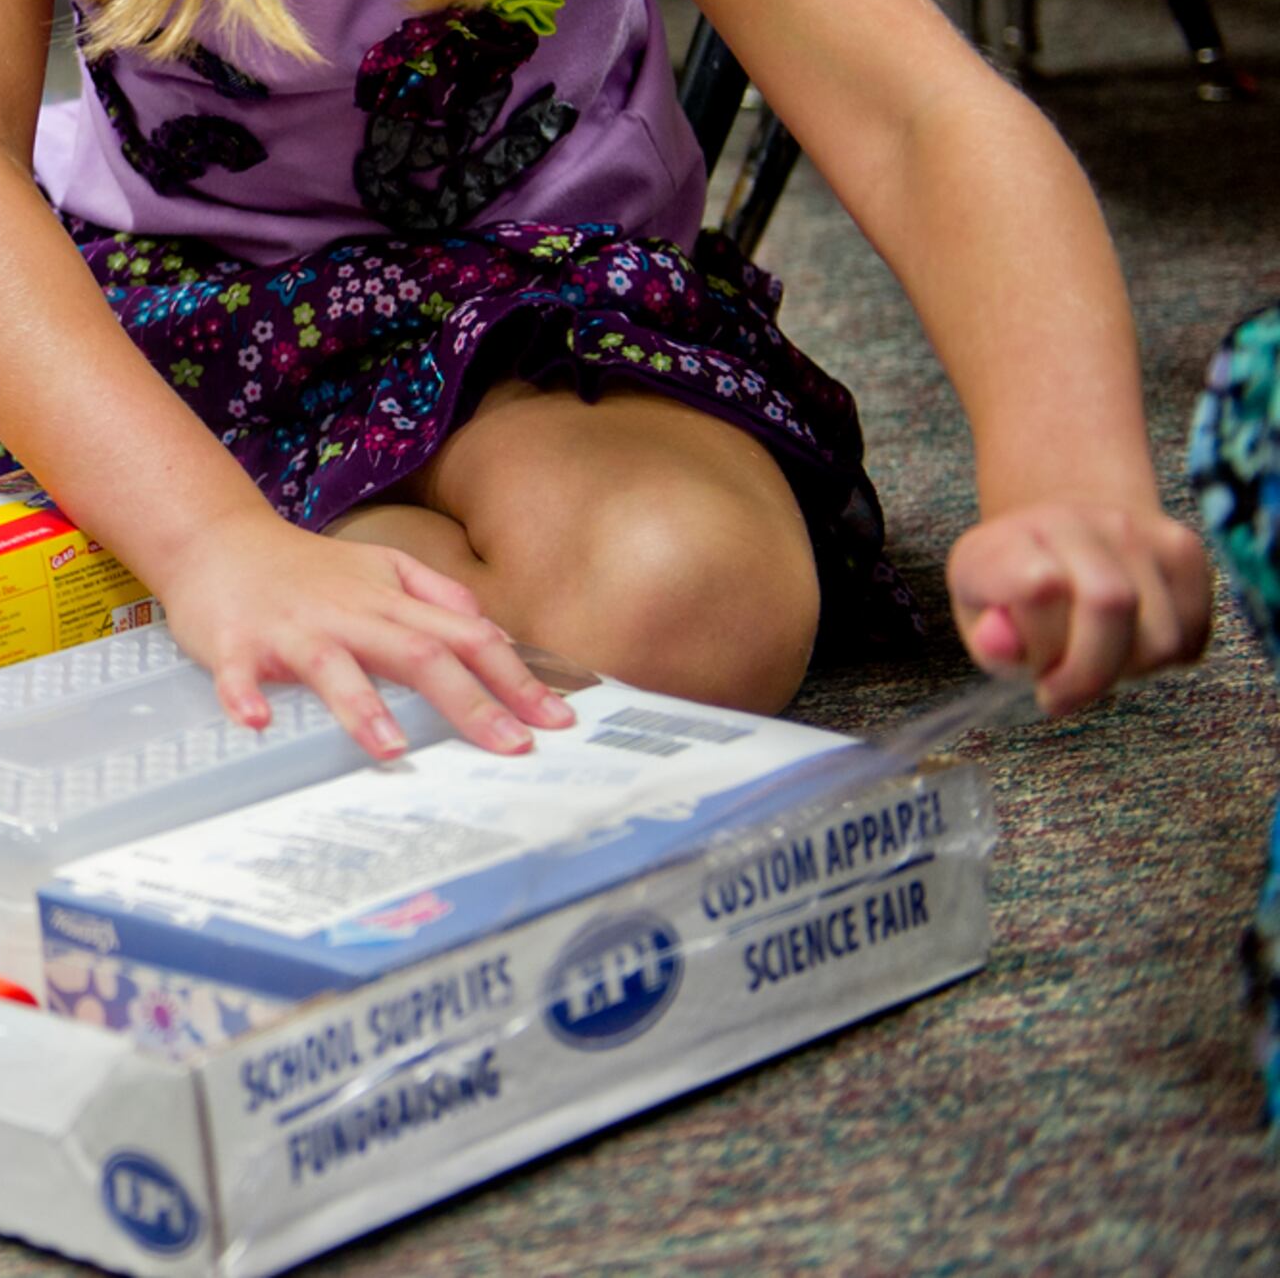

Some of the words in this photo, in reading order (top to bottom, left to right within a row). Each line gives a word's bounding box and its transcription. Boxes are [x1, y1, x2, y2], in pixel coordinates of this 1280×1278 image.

[700, 833, 819, 921] CUSTOM
[743, 905, 861, 992] SCIENCE
[864, 879, 930, 945] FAIR
[242, 1018, 360, 1112] SCHOOL
[366, 954, 513, 1056] SUPPLIES
[288, 1045, 502, 1188] FUNDRAISING
